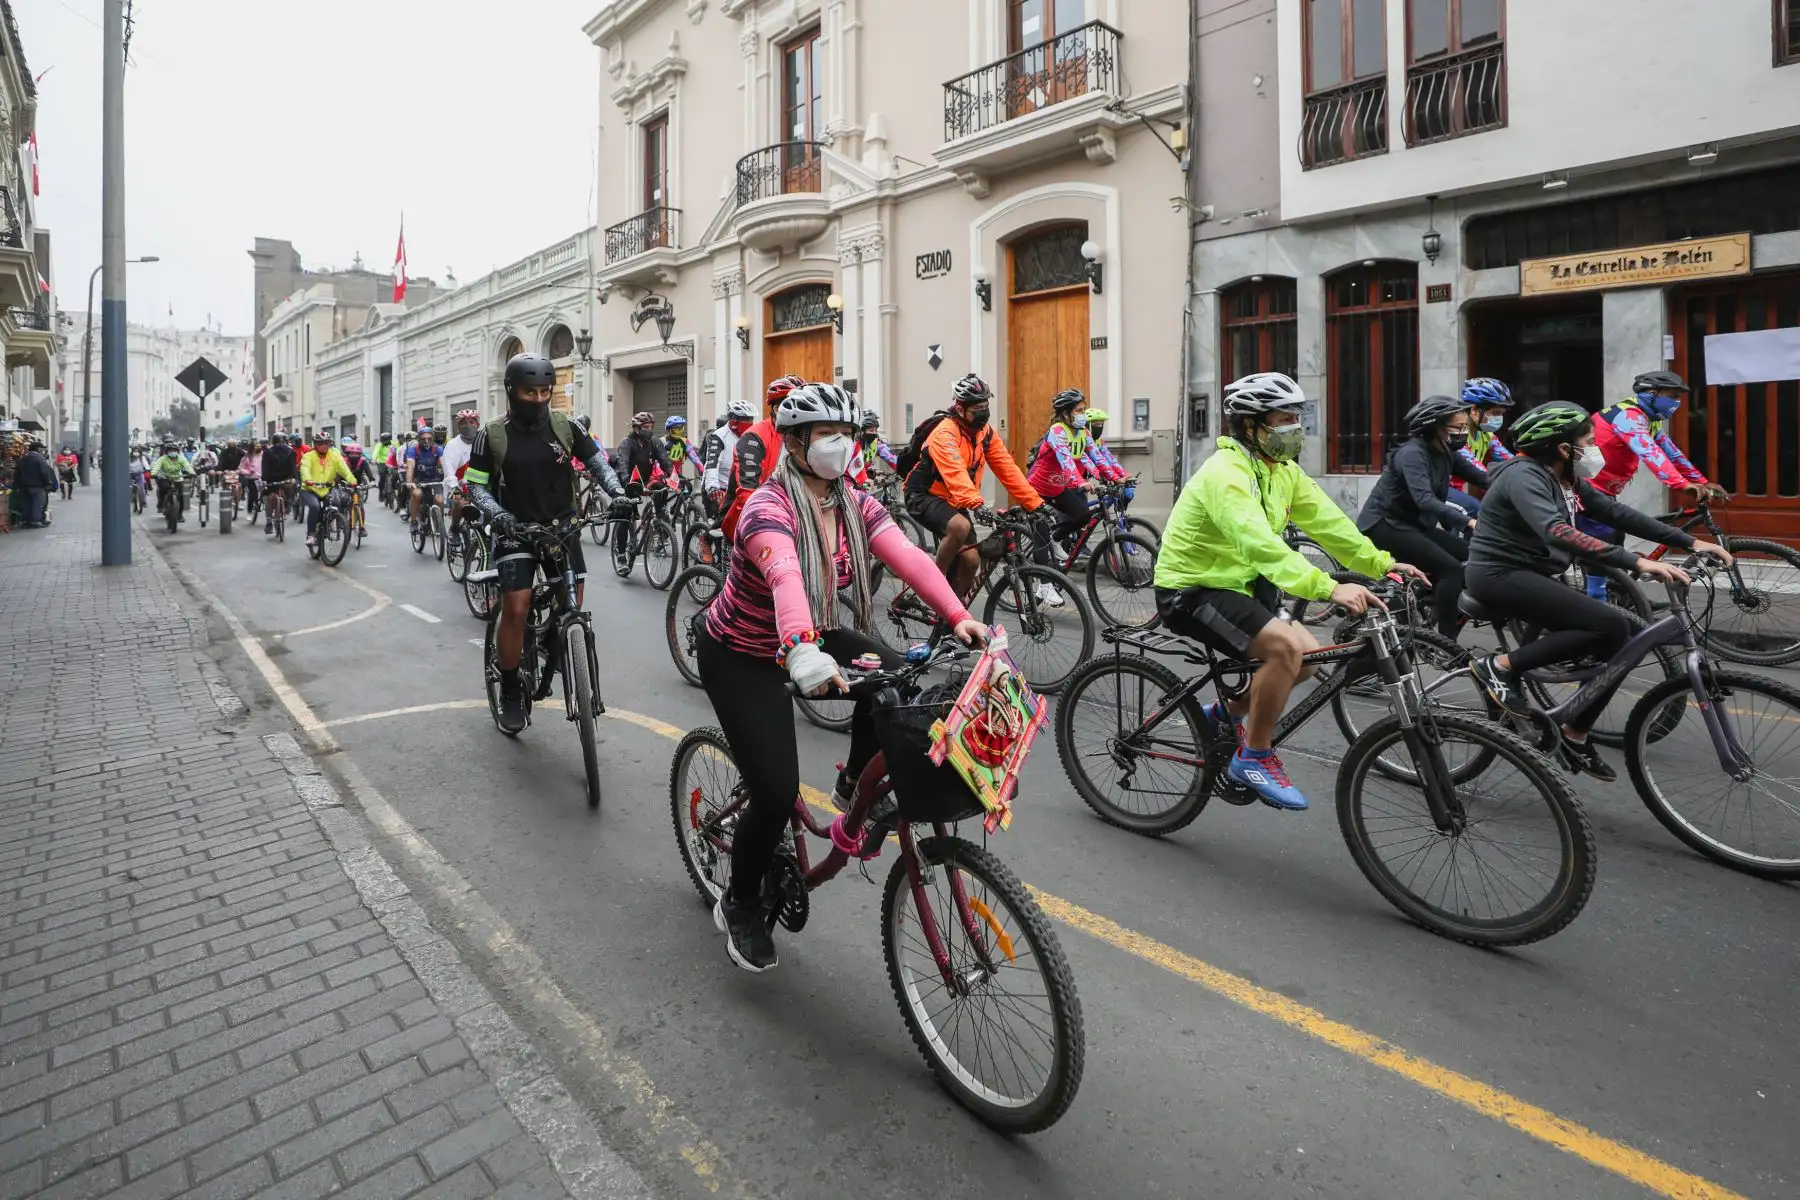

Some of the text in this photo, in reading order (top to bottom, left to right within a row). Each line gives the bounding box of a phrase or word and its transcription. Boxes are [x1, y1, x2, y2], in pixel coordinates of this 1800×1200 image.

[916, 249, 952, 279] ESTADIO
[1550, 247, 1713, 279] La Estrella de Belén
[1281, 683, 1332, 731] MOSSO
